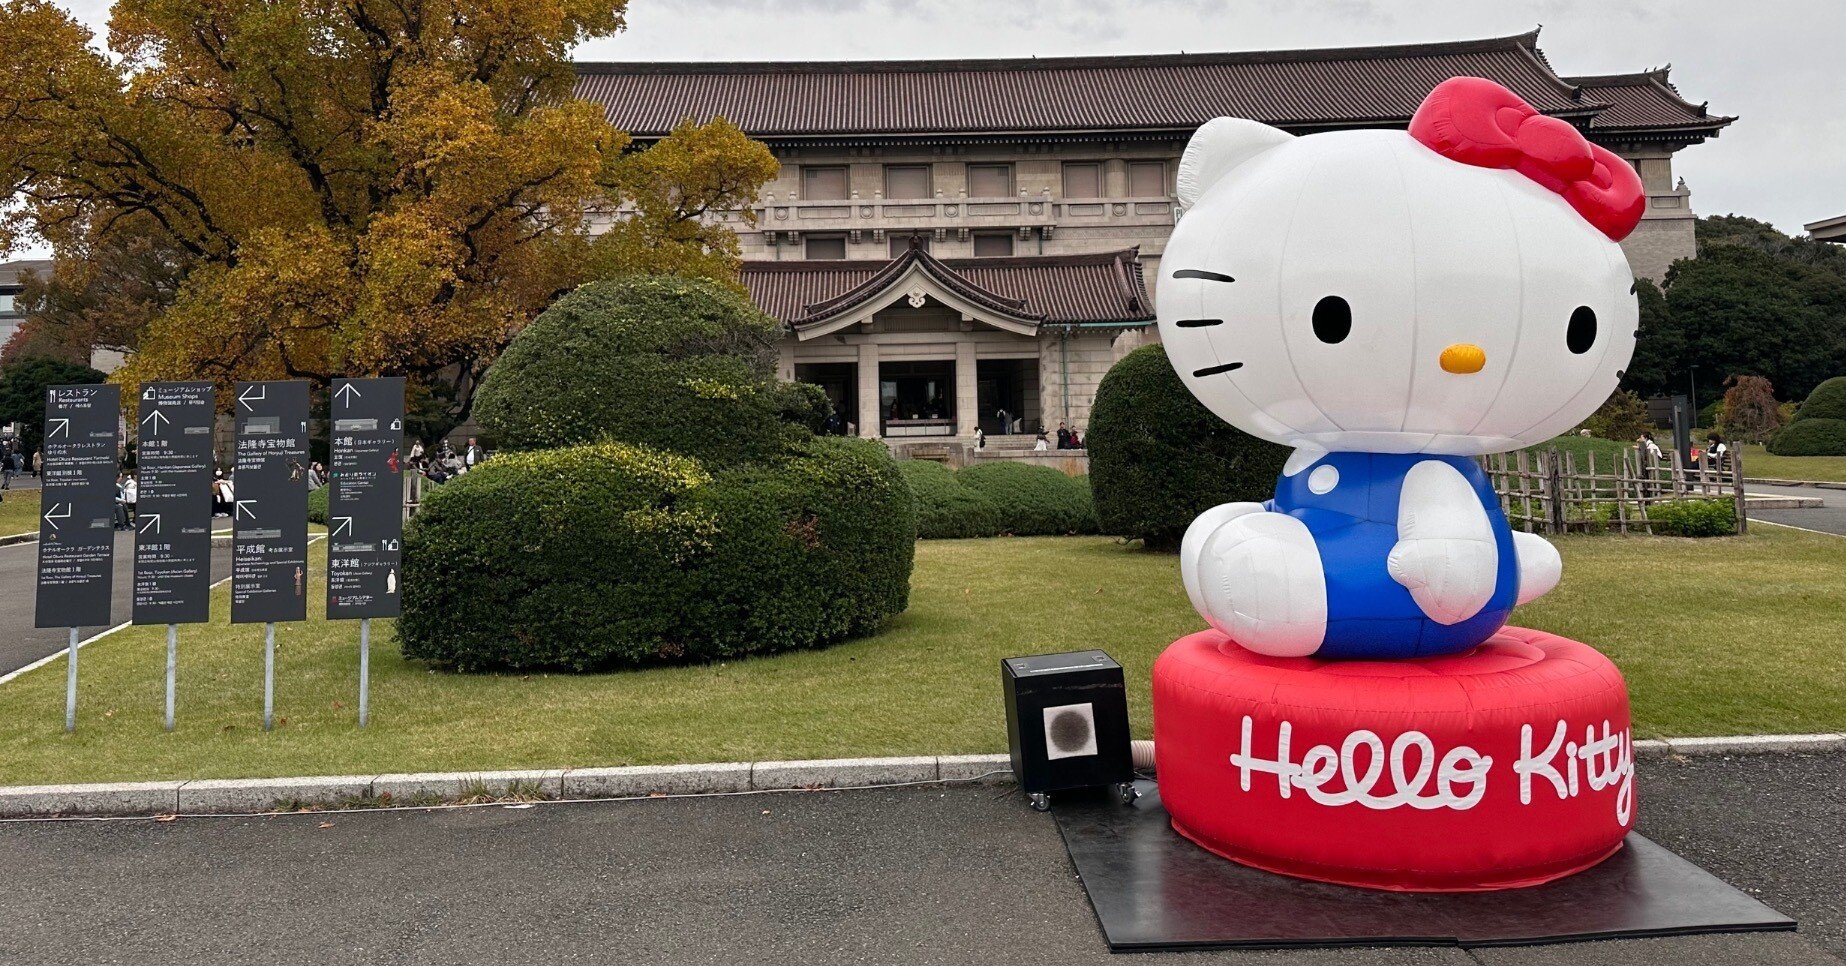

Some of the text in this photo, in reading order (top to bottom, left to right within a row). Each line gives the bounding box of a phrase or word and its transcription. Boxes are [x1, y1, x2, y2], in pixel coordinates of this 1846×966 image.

[58, 388, 98, 397] レストラン
[238, 438, 295, 449] 法隆寺宝物館
[334, 437, 353, 446] 本館
[236, 544, 265, 554] 平成館
[331, 558, 359, 568] 東洋館
[1229, 714, 1635, 827] Hello Kitty
